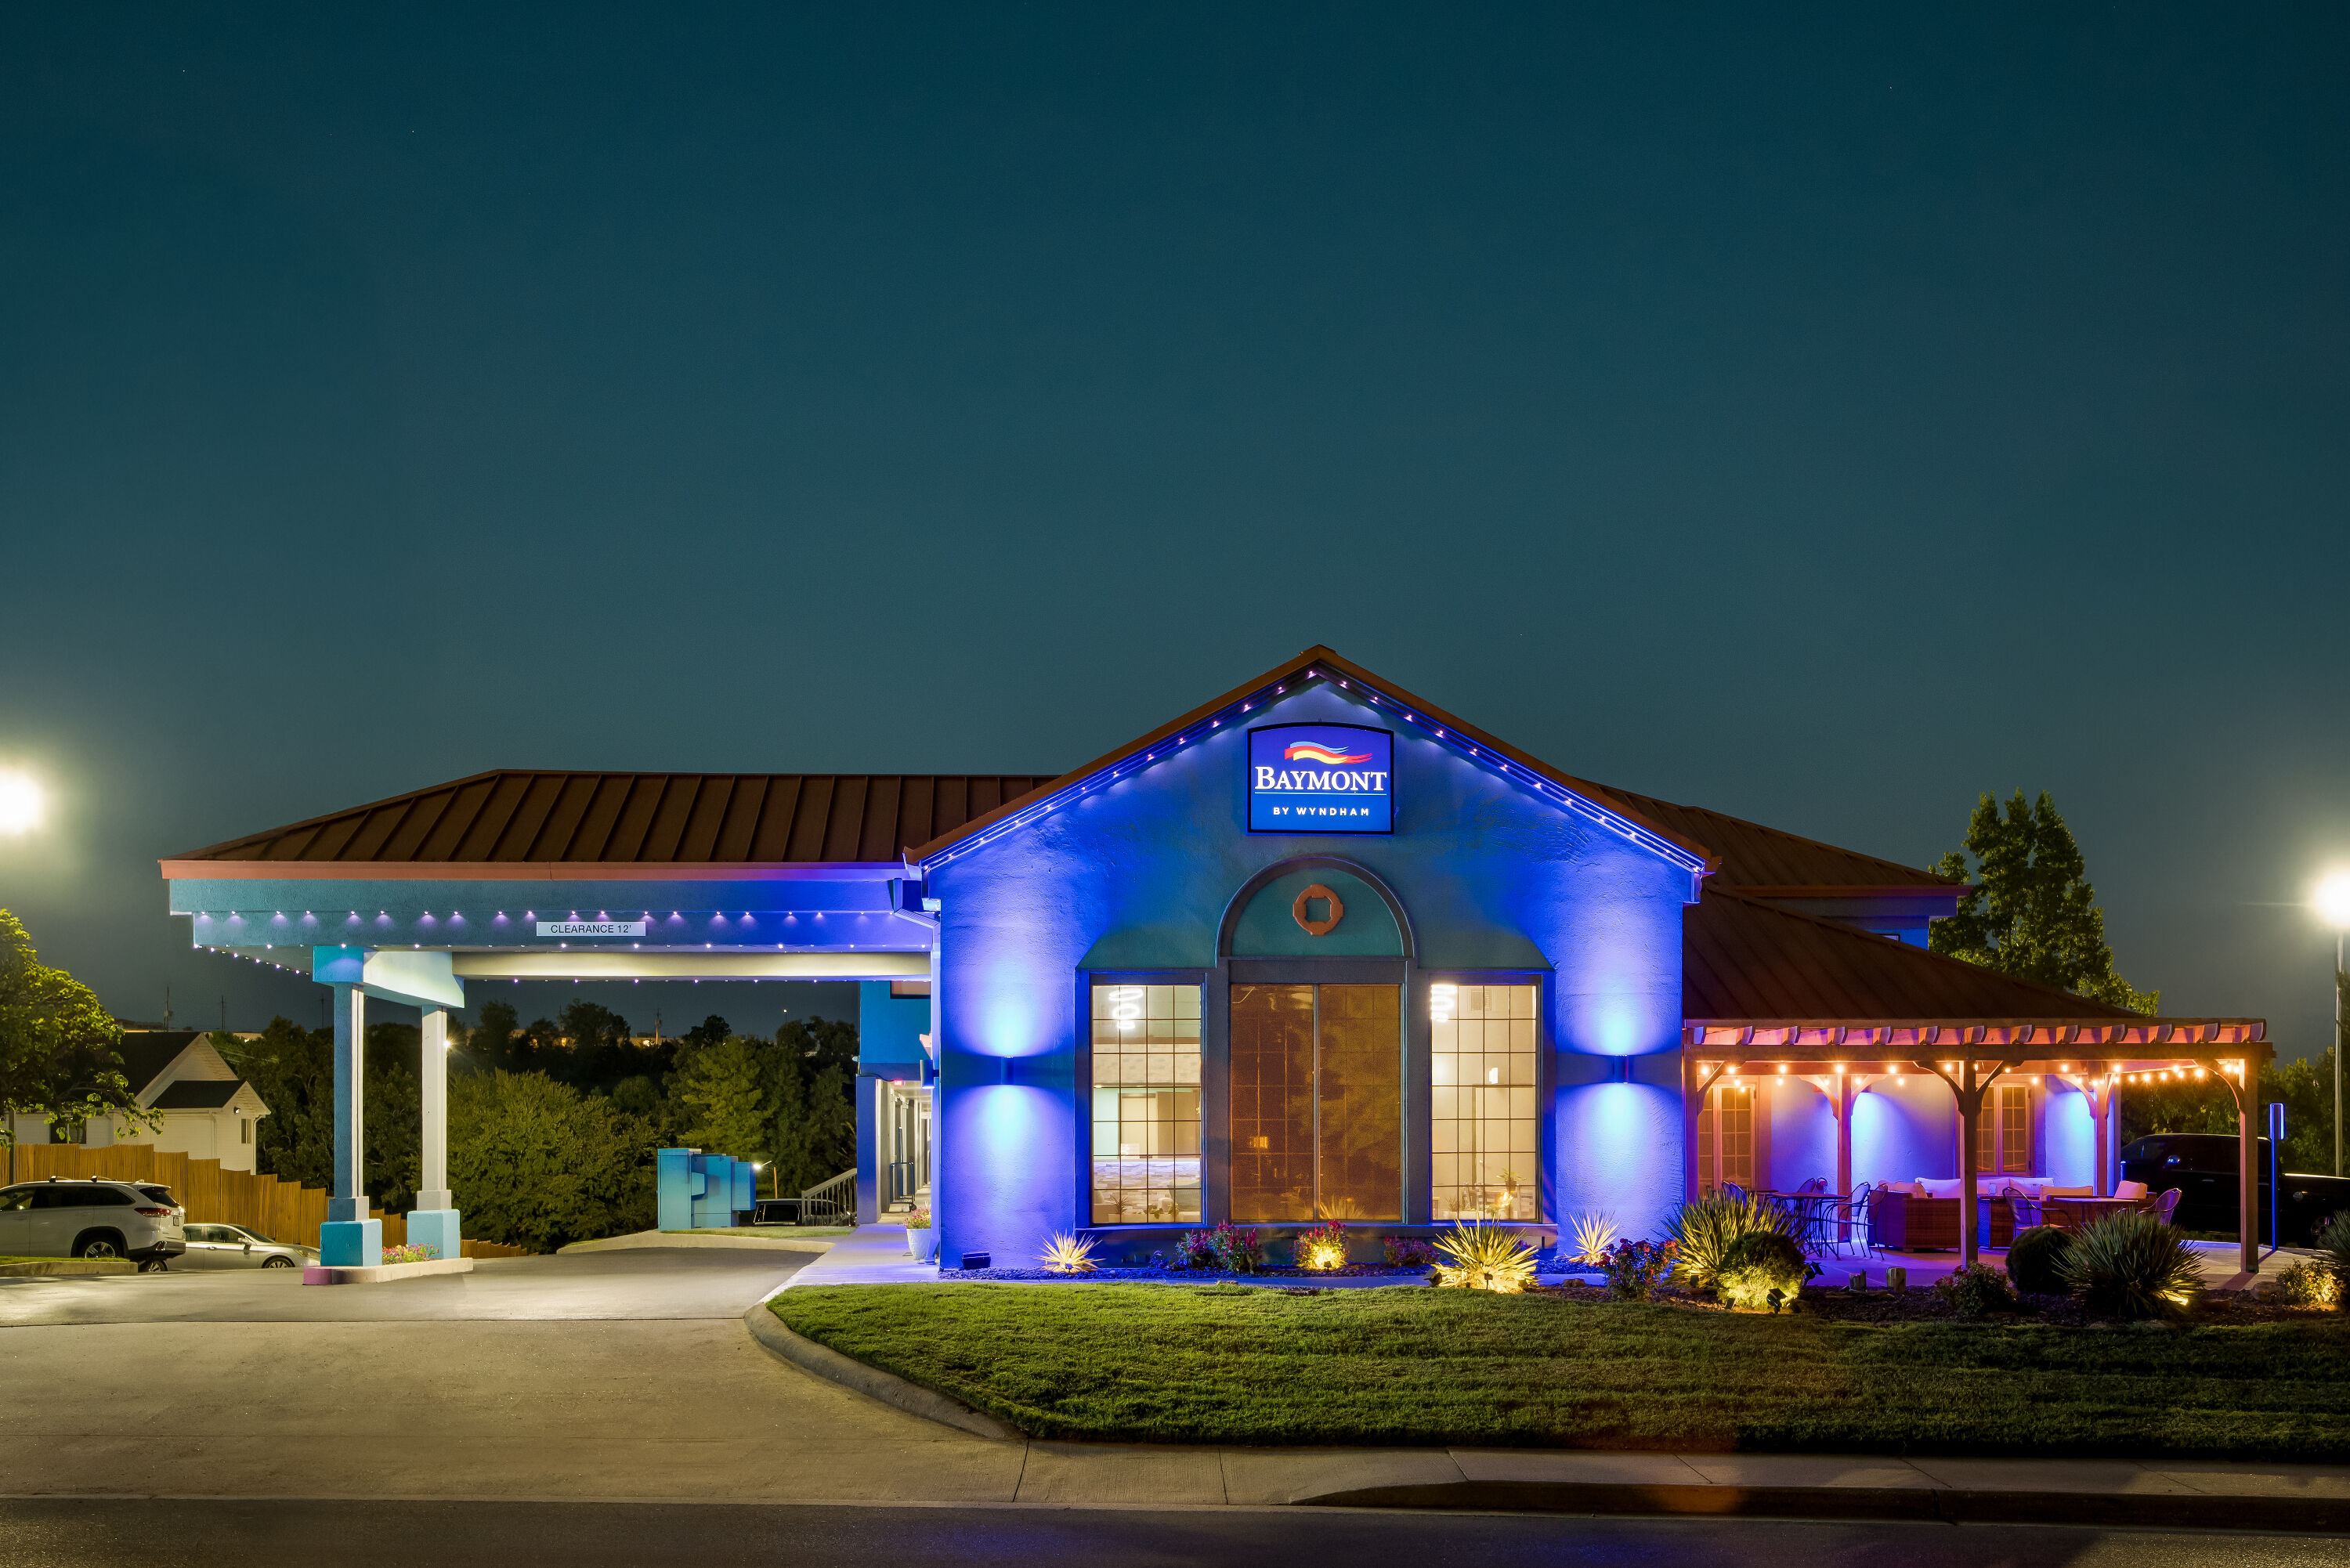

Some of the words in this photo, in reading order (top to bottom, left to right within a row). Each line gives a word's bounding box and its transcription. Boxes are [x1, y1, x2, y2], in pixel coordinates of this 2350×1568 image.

[1254, 766, 1387, 791] BAYMONT
[1273, 807, 1289, 815] BY
[1296, 807, 1369, 816] WYNDHAM
[550, 924, 614, 934] CLEARANCE
[616, 924, 631, 934] 12'
